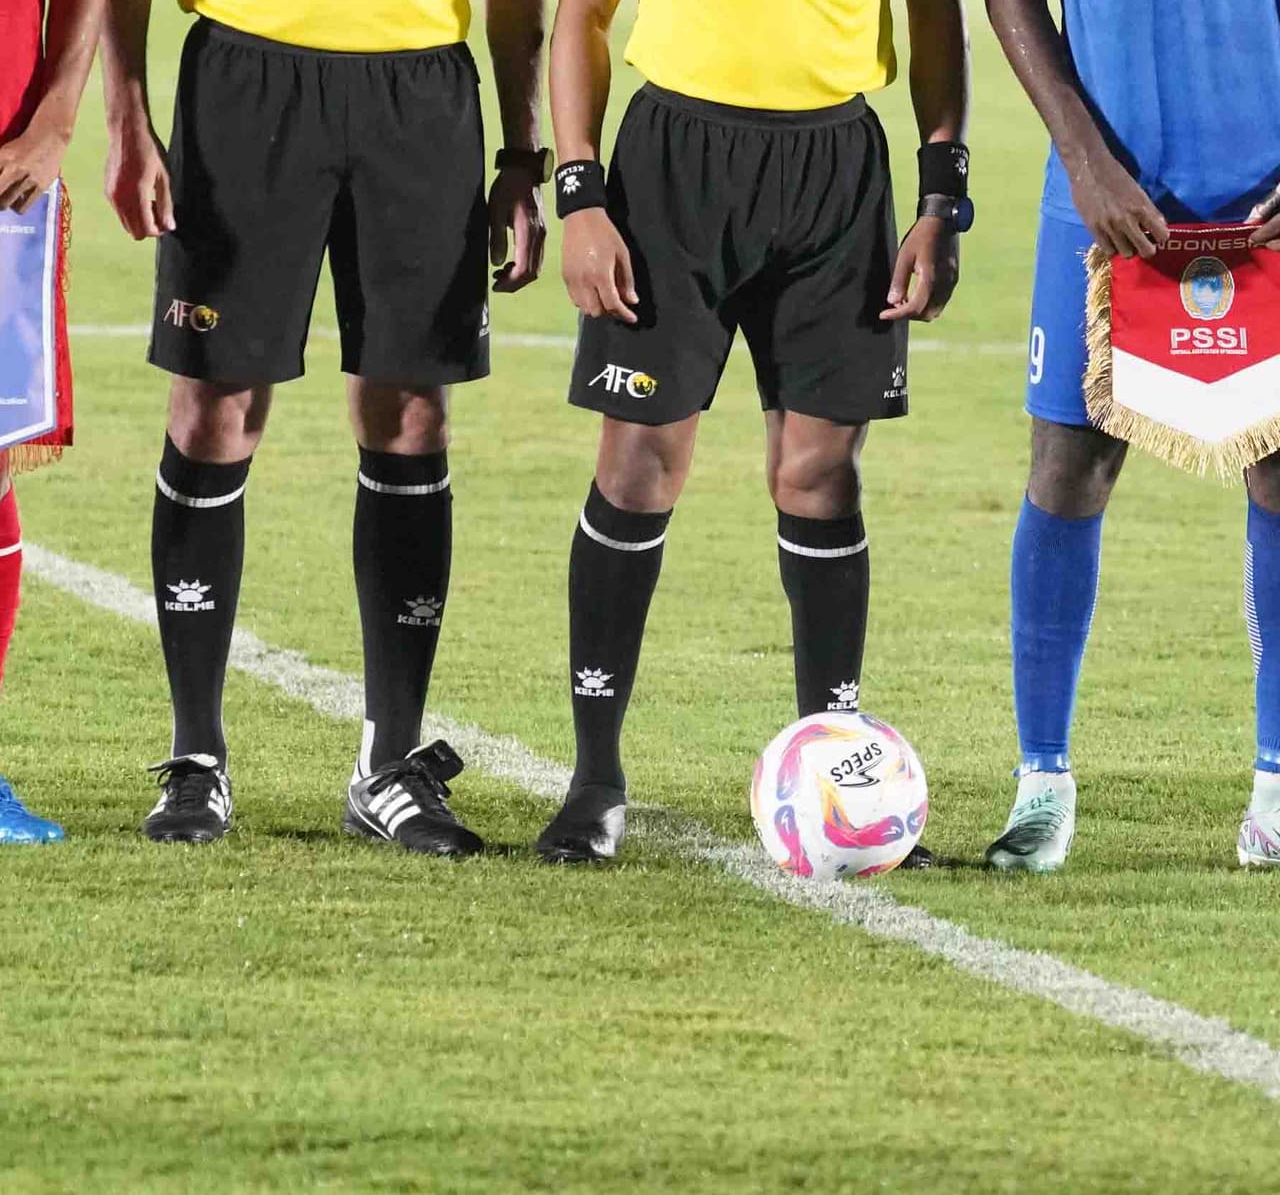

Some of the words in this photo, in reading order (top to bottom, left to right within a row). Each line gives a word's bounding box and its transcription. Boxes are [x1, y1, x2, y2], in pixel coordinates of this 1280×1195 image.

[1170, 327, 1248, 349] PSSI
[1030, 327, 1046, 384] 9
[165, 600, 215, 611] KELME
[575, 686, 614, 697] KELME
[830, 743, 883, 783] SPECS
